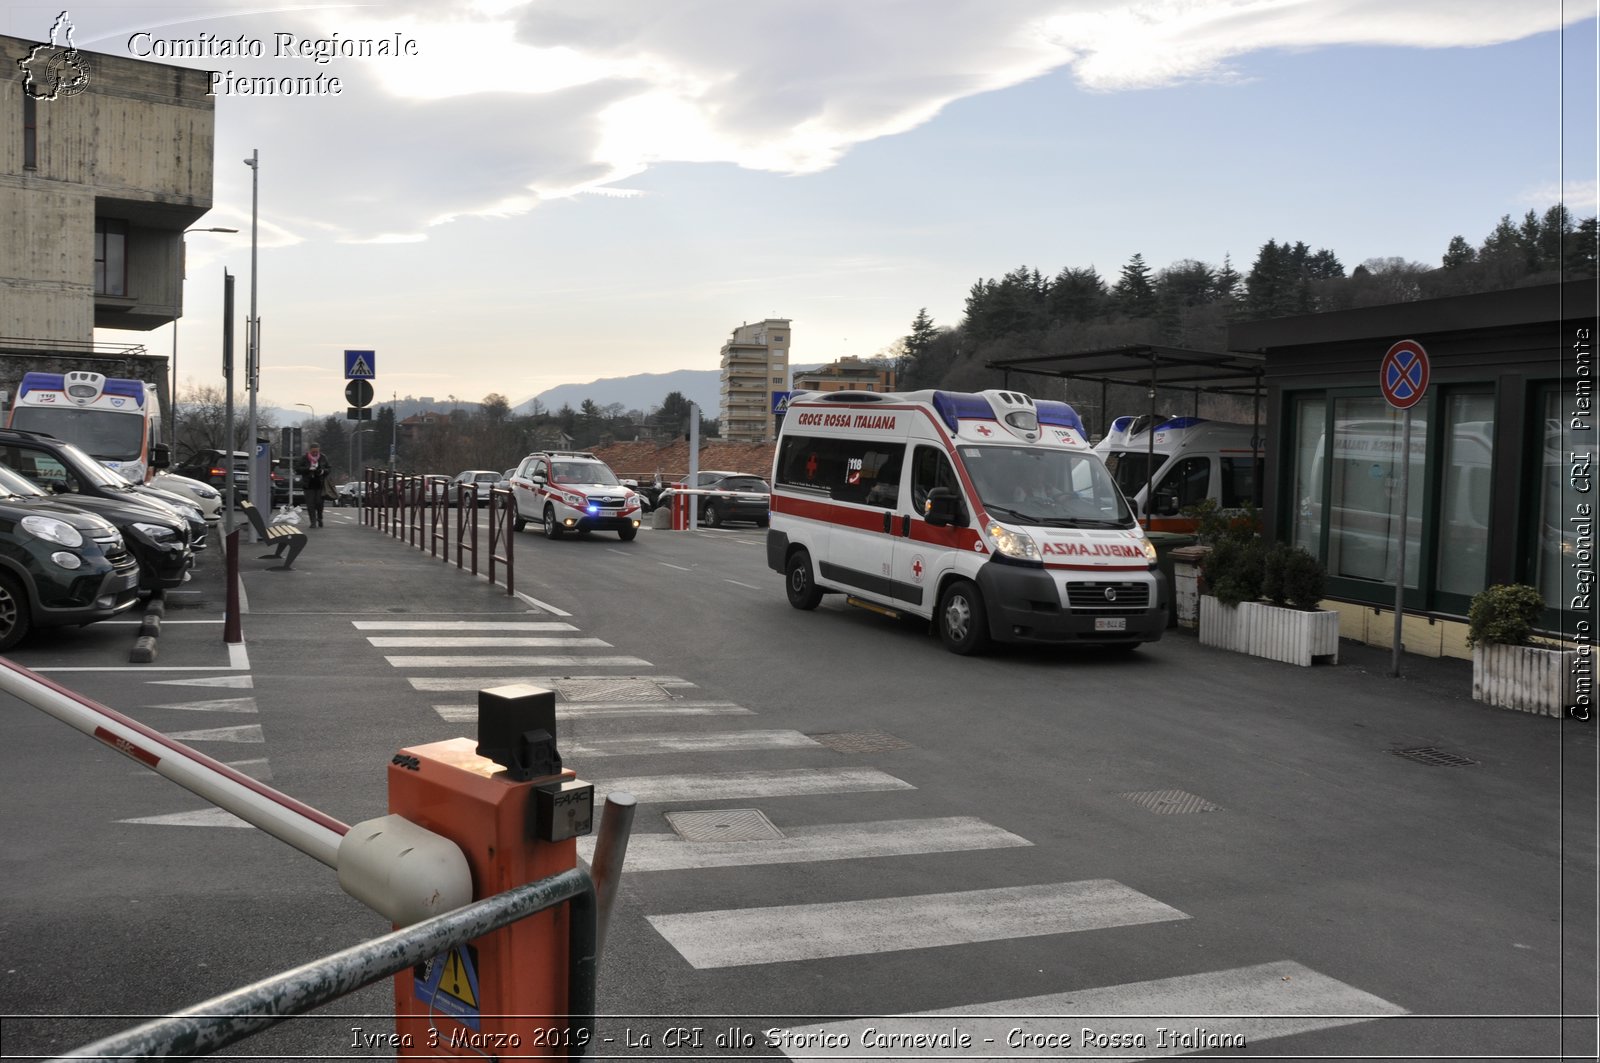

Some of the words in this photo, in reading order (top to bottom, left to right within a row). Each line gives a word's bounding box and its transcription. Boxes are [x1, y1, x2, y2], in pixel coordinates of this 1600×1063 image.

[798, 413, 824, 426] CROCE
[824, 414, 852, 428] ROSSA
[853, 415, 896, 430] ITALIANA
[849, 458, 863, 470] 118
[555, 791, 589, 807] FAAC
